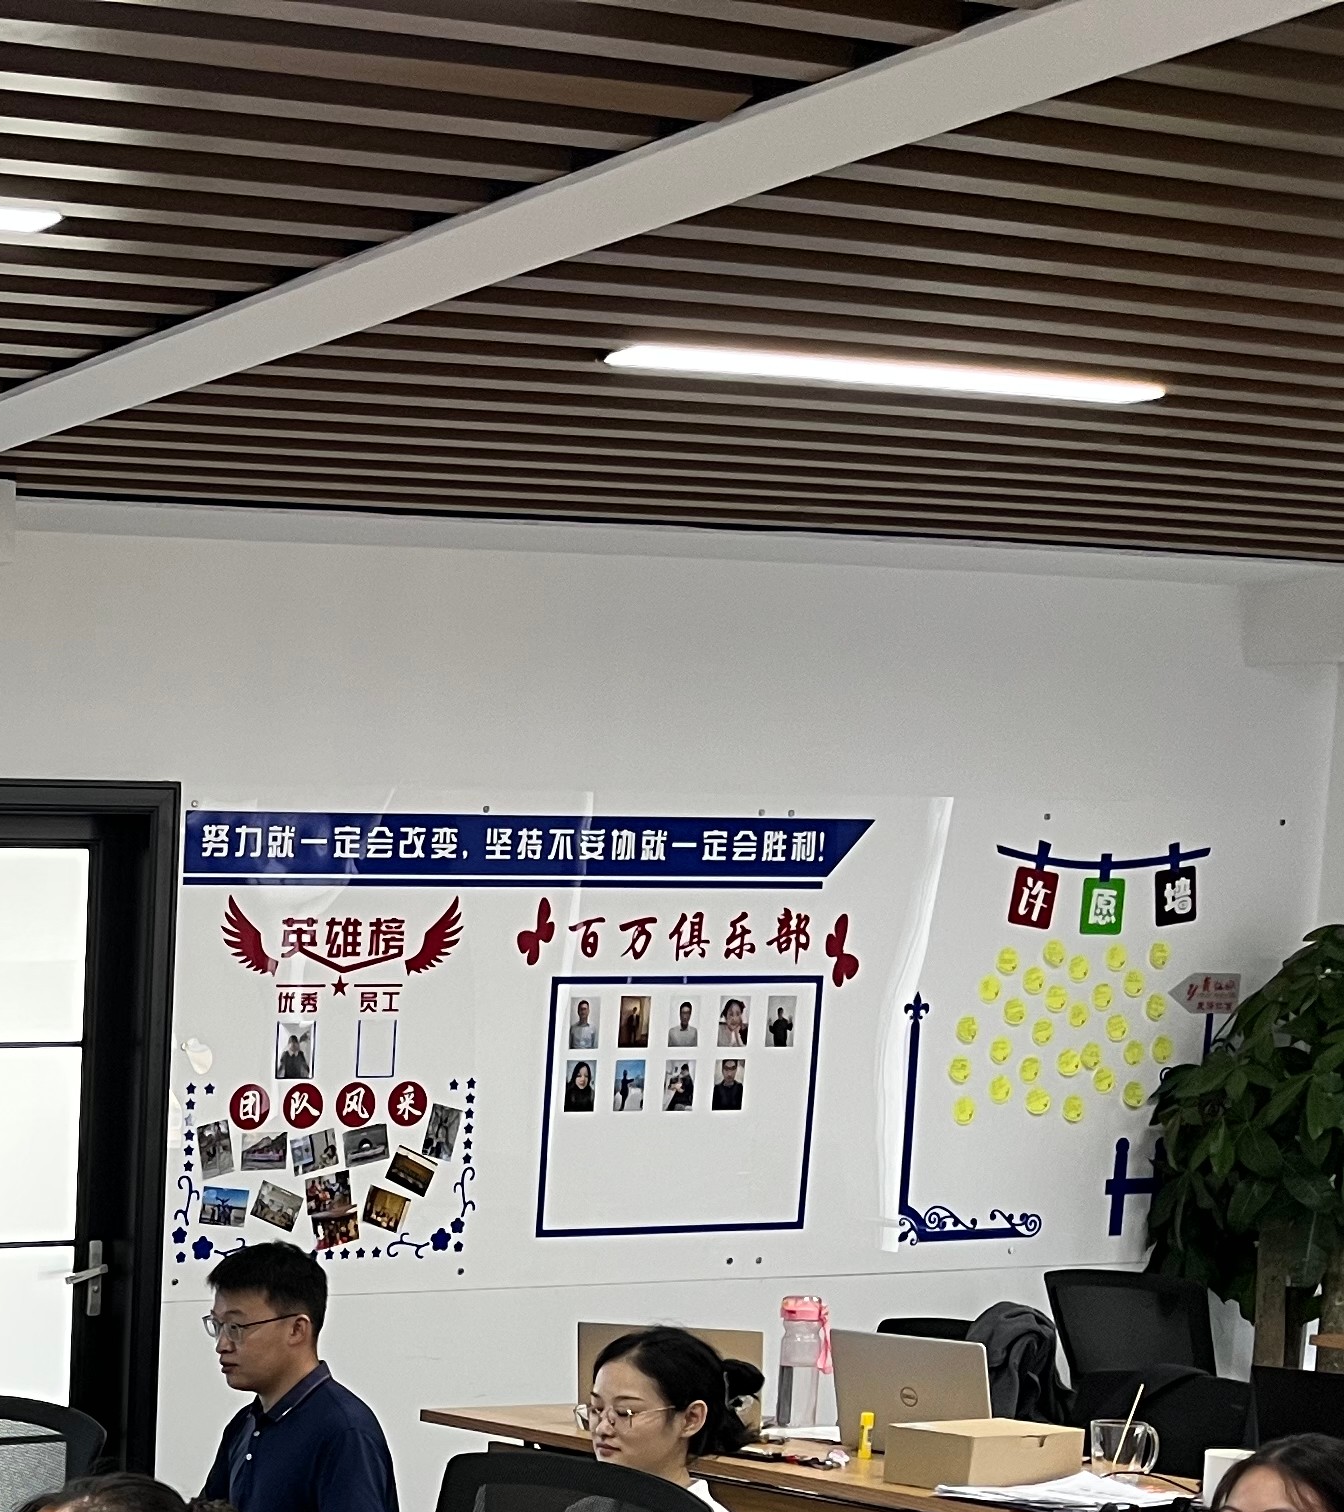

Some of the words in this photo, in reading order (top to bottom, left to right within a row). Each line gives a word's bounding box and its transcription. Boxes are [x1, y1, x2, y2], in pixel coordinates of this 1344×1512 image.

[281, 917, 406, 959] 英雄榜
[568, 907, 811, 965] 百万俱乐部
[277, 991, 319, 1014] 优秀
[359, 991, 400, 1013] 员工
[238, 1084, 423, 1122] 团队风采
